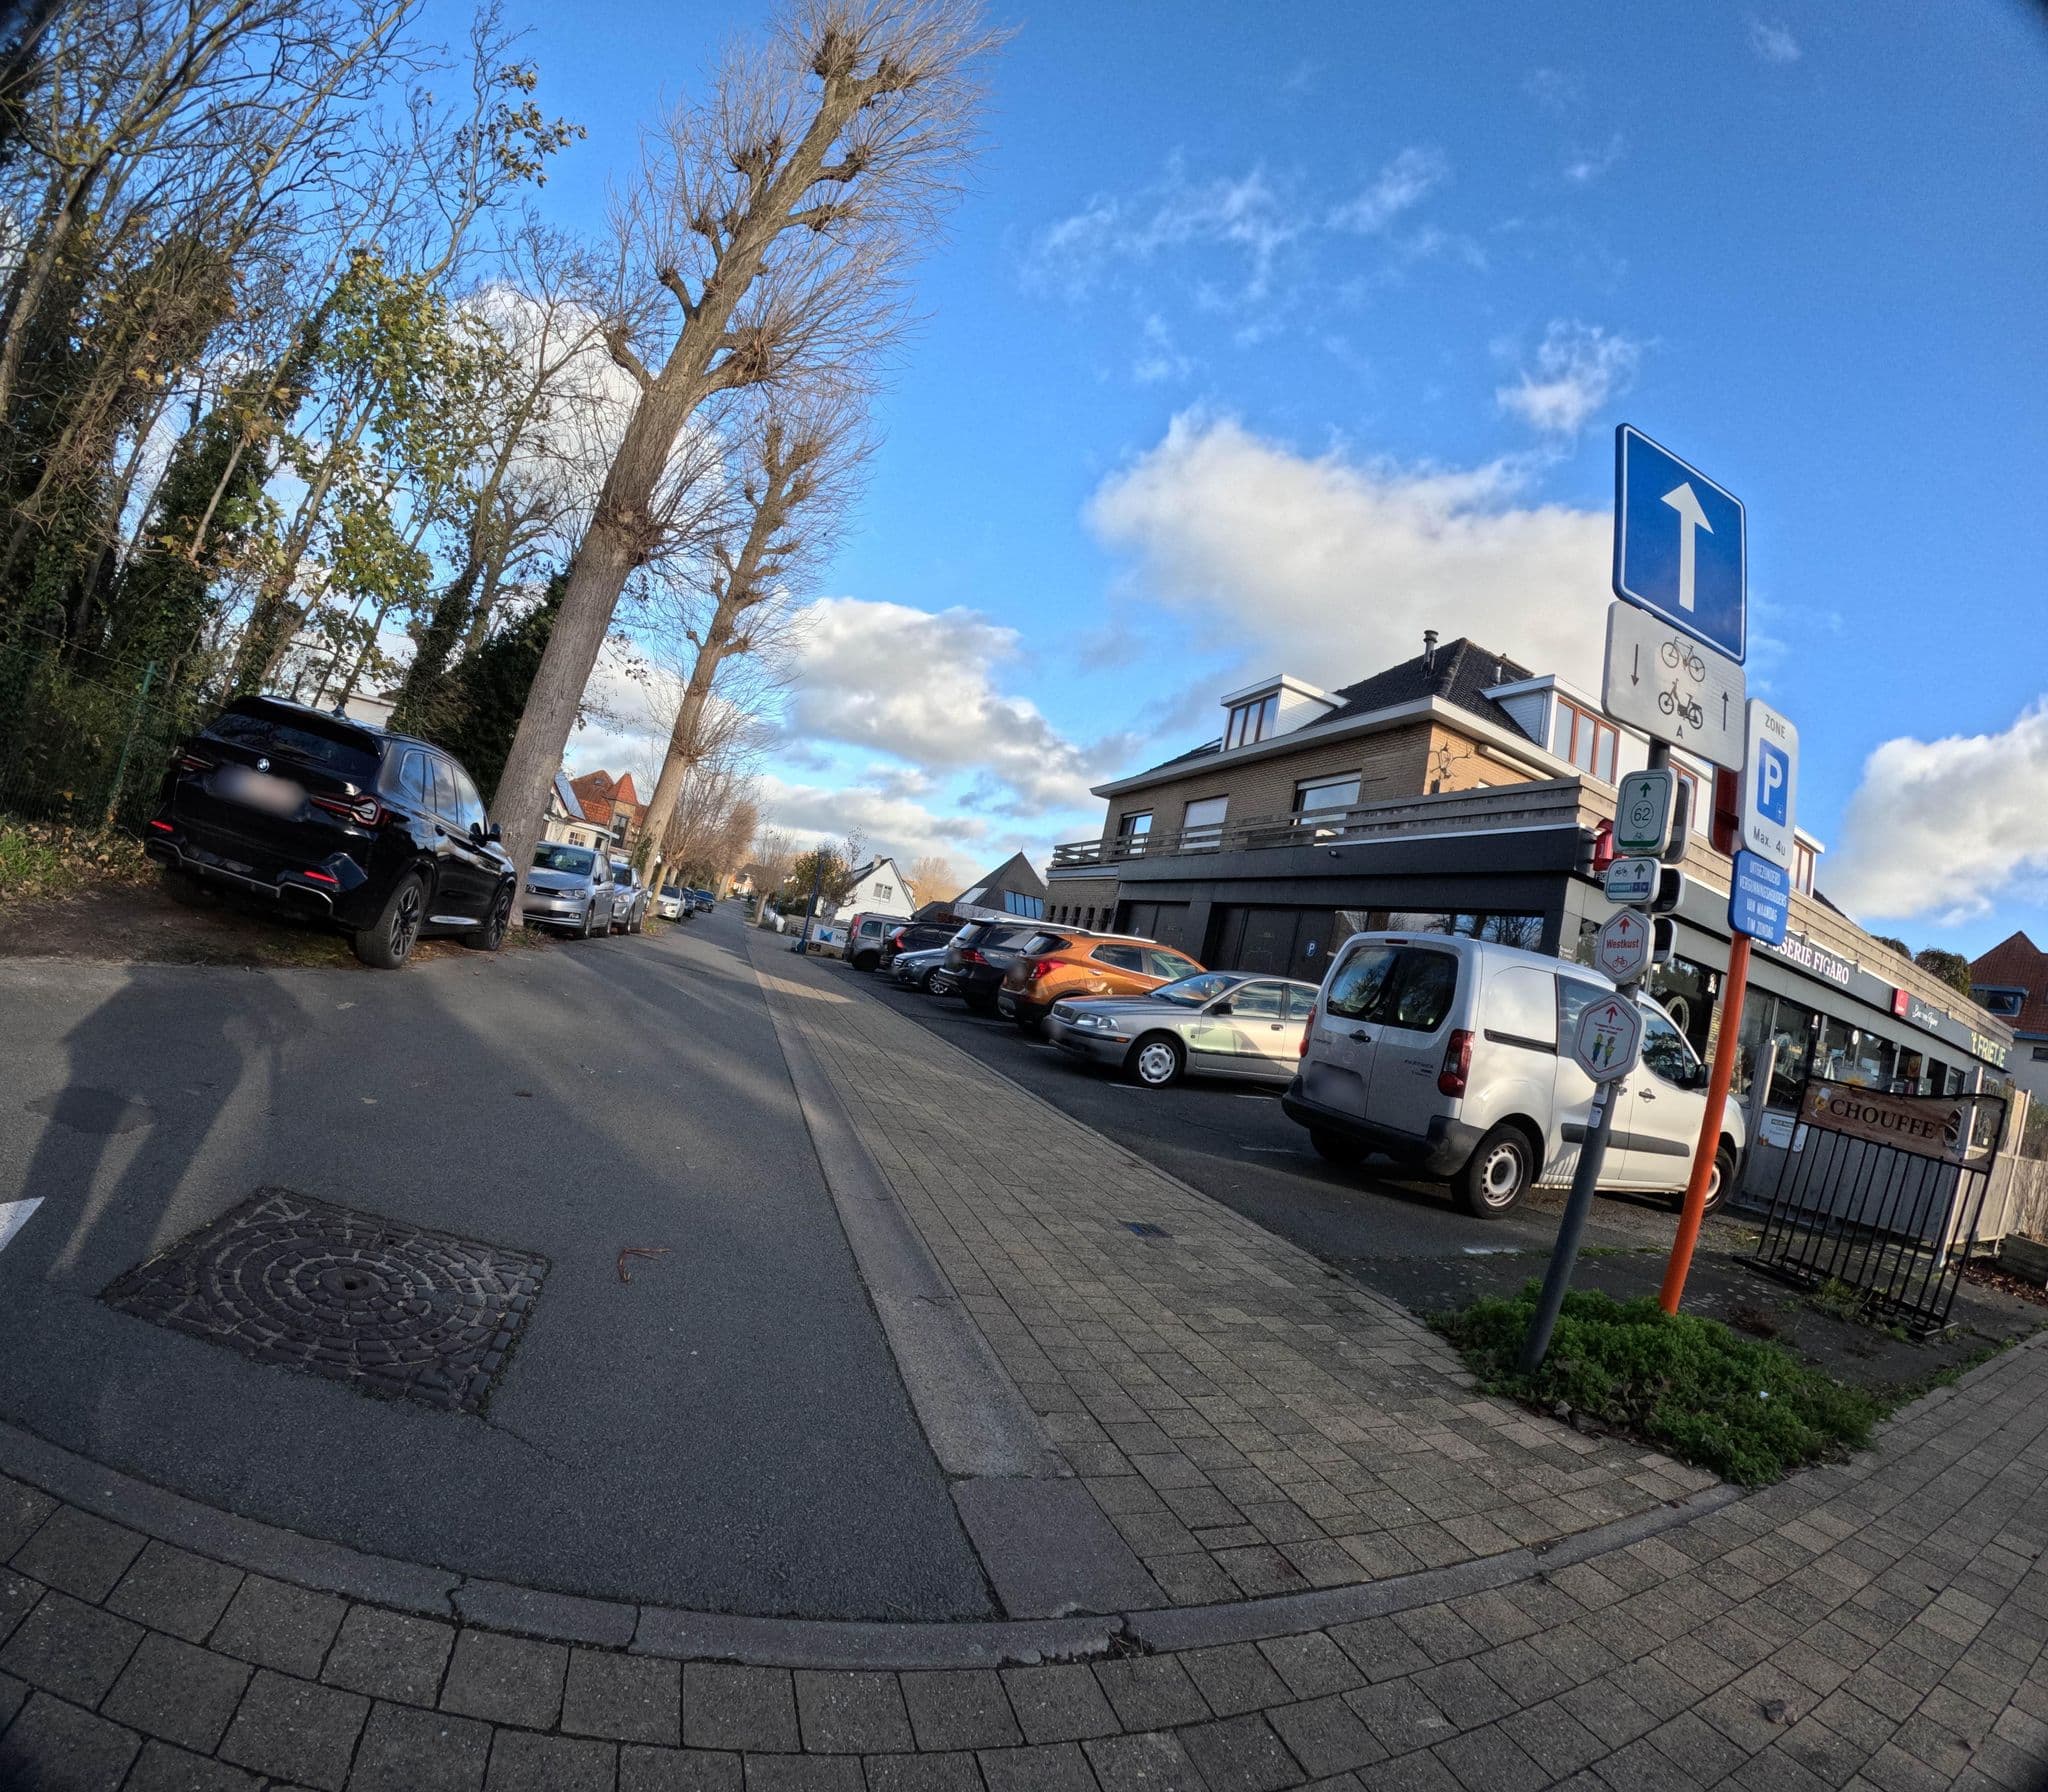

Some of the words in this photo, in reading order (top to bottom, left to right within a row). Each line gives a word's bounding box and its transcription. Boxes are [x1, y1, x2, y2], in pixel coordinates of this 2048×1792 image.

[1676, 724, 1684, 739] A
[1765, 713, 1785, 740] ZONE
[1763, 752, 1782, 806] P
[1633, 806, 1651, 822] 62
[1754, 826, 1771, 848] Max.
[1776, 840, 1786, 857] 4u
[1605, 939, 1640, 949] Westkust
[1814, 951, 1850, 985] FIGARO
[1829, 1099, 1936, 1139] CHOUFFE
